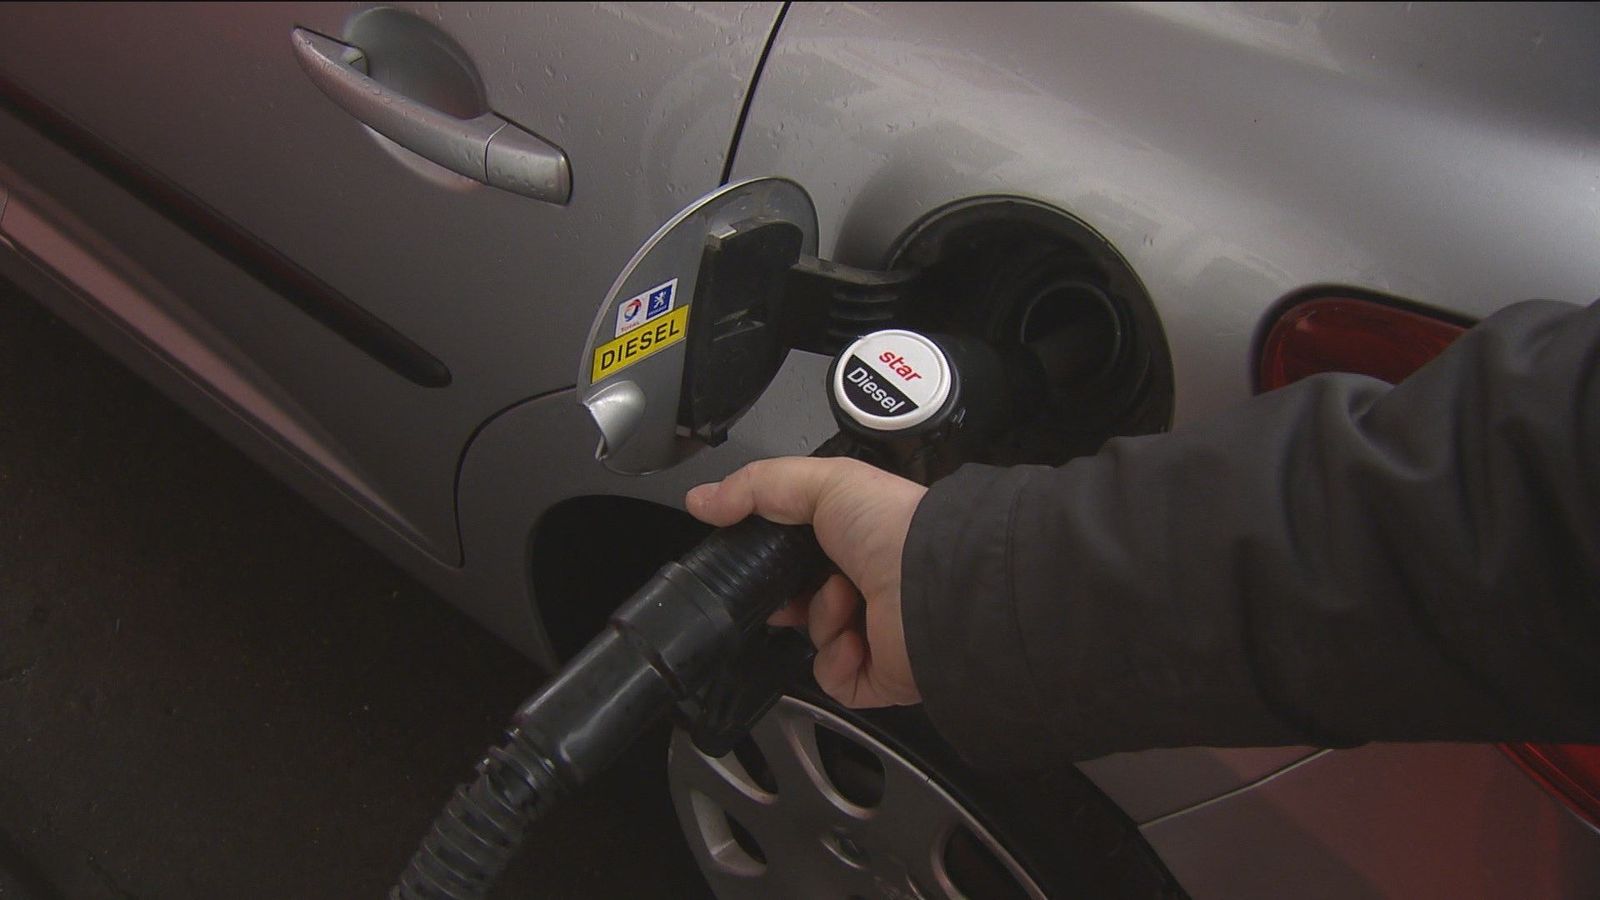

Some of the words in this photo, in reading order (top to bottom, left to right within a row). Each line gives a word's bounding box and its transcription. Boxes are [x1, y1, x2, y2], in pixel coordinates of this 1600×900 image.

[600, 319, 680, 371] DIESEL
[879, 351, 922, 382] star
[847, 367, 905, 413] Diesel
